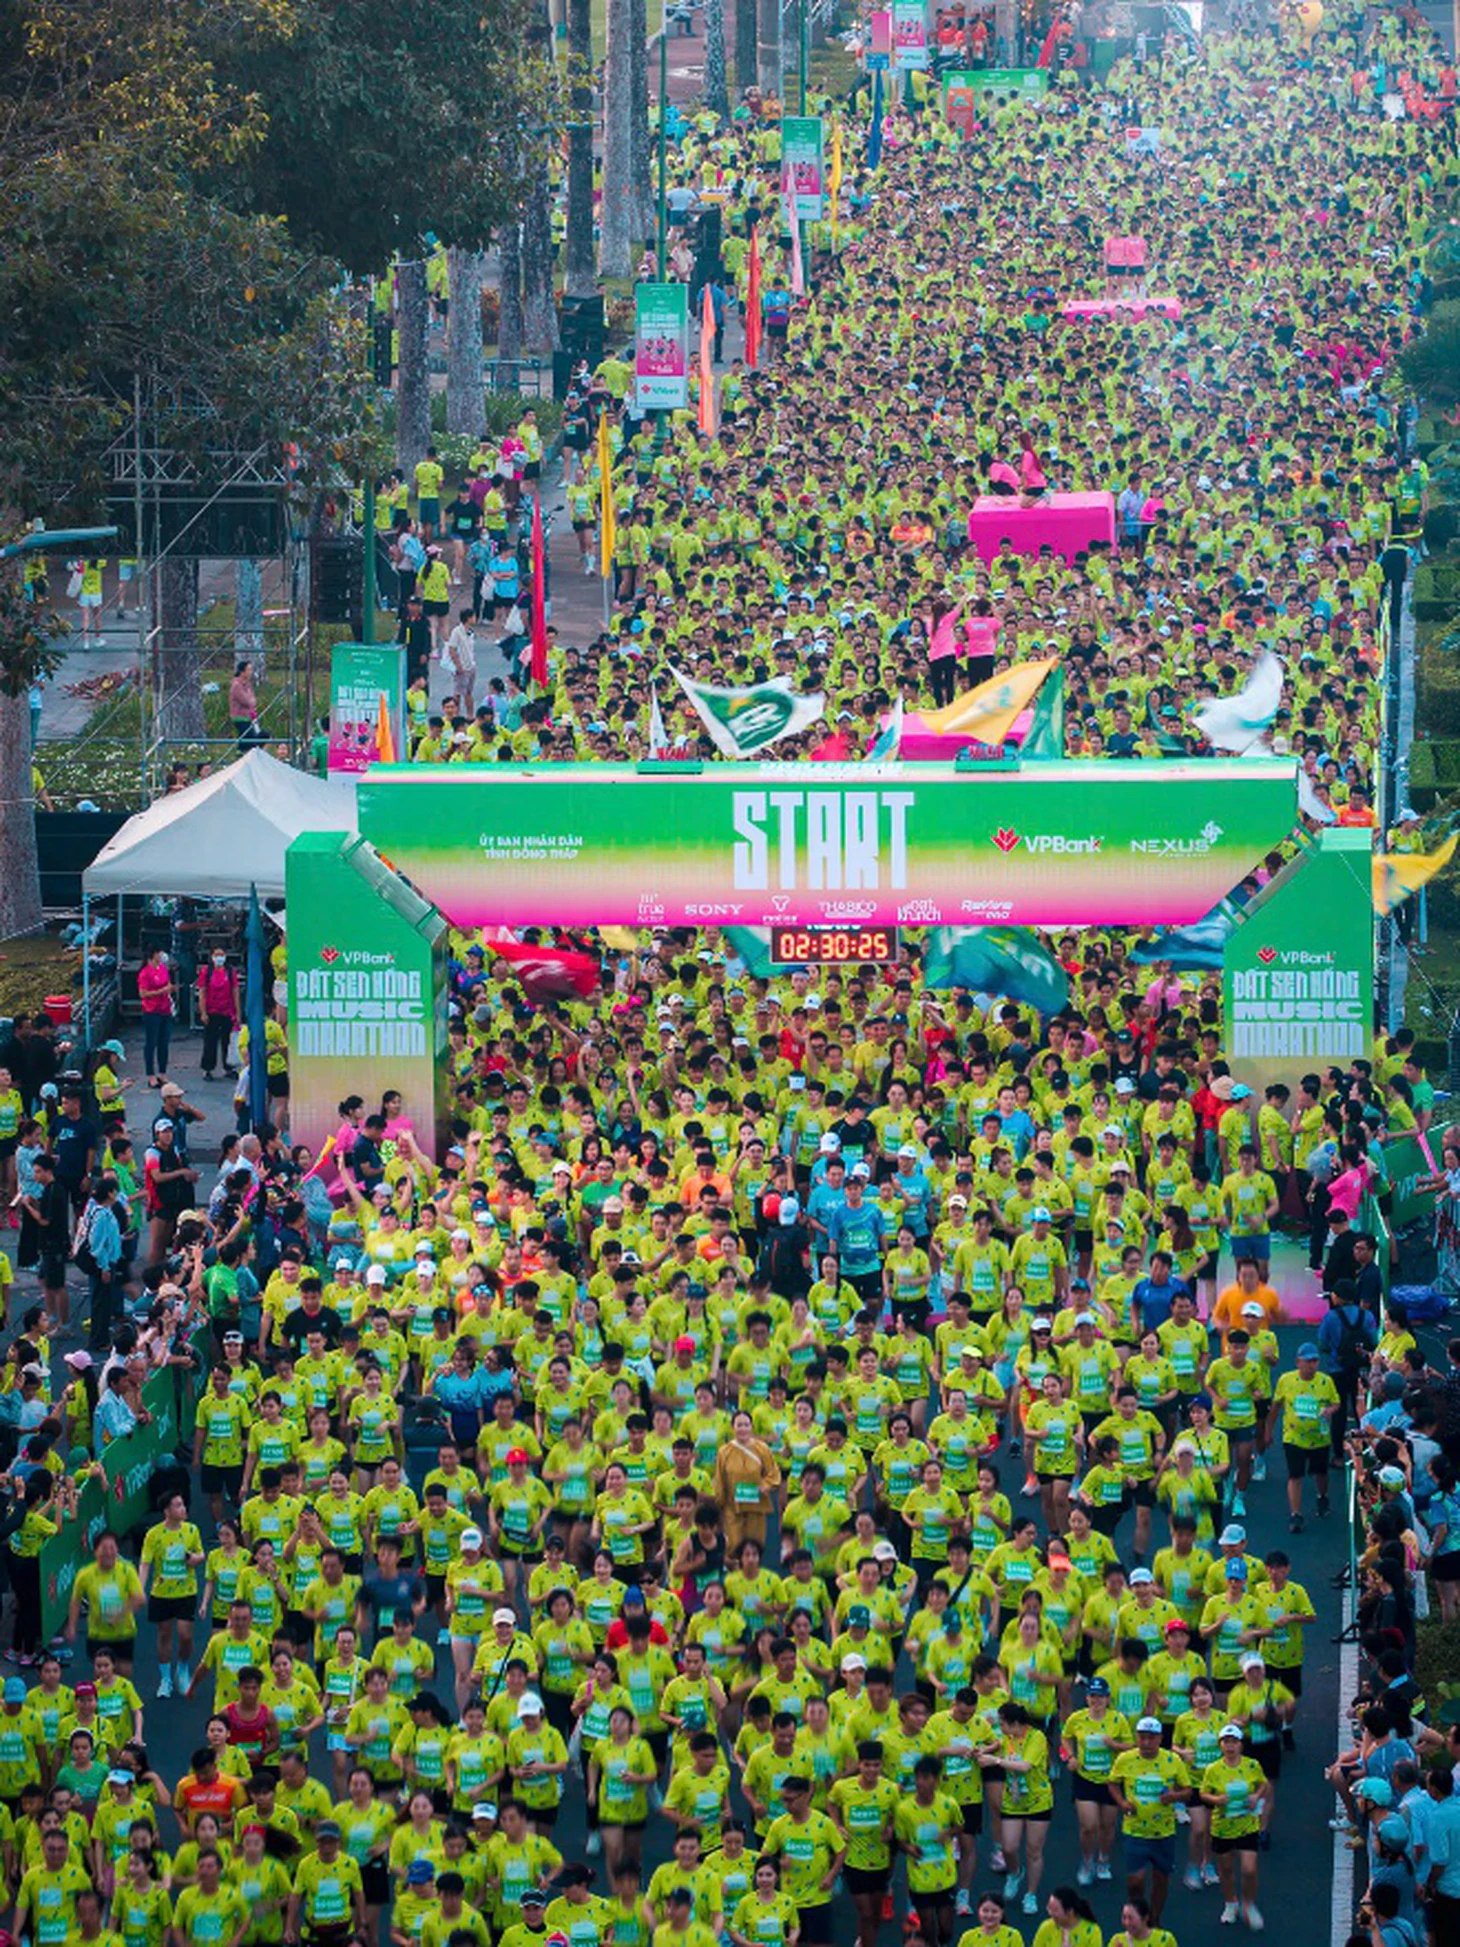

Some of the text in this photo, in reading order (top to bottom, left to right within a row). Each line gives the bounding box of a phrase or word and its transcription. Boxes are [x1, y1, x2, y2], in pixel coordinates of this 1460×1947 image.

[497, 835, 521, 846] BAN
[523, 833, 556, 846] NHÂN
[558, 833, 583, 846] DÂN
[733, 792, 915, 890] START
[1025, 835, 1102, 854] VPBank
[1131, 838, 1210, 857] NEXUS
[684, 904, 743, 917] SONY
[780, 933, 889, 959] 02:30:25
[342, 950, 396, 965] VPBank
[1280, 950, 1334, 965] VPBank
[333, 970, 370, 999] SEN
[1270, 970, 1308, 999] SEN
[297, 1001, 425, 1019] MUSIC
[1232, 1001, 1364, 1019] MUSIC
[297, 1022, 426, 1057] MARATHON
[1233, 1022, 1364, 1058] MARATHON
